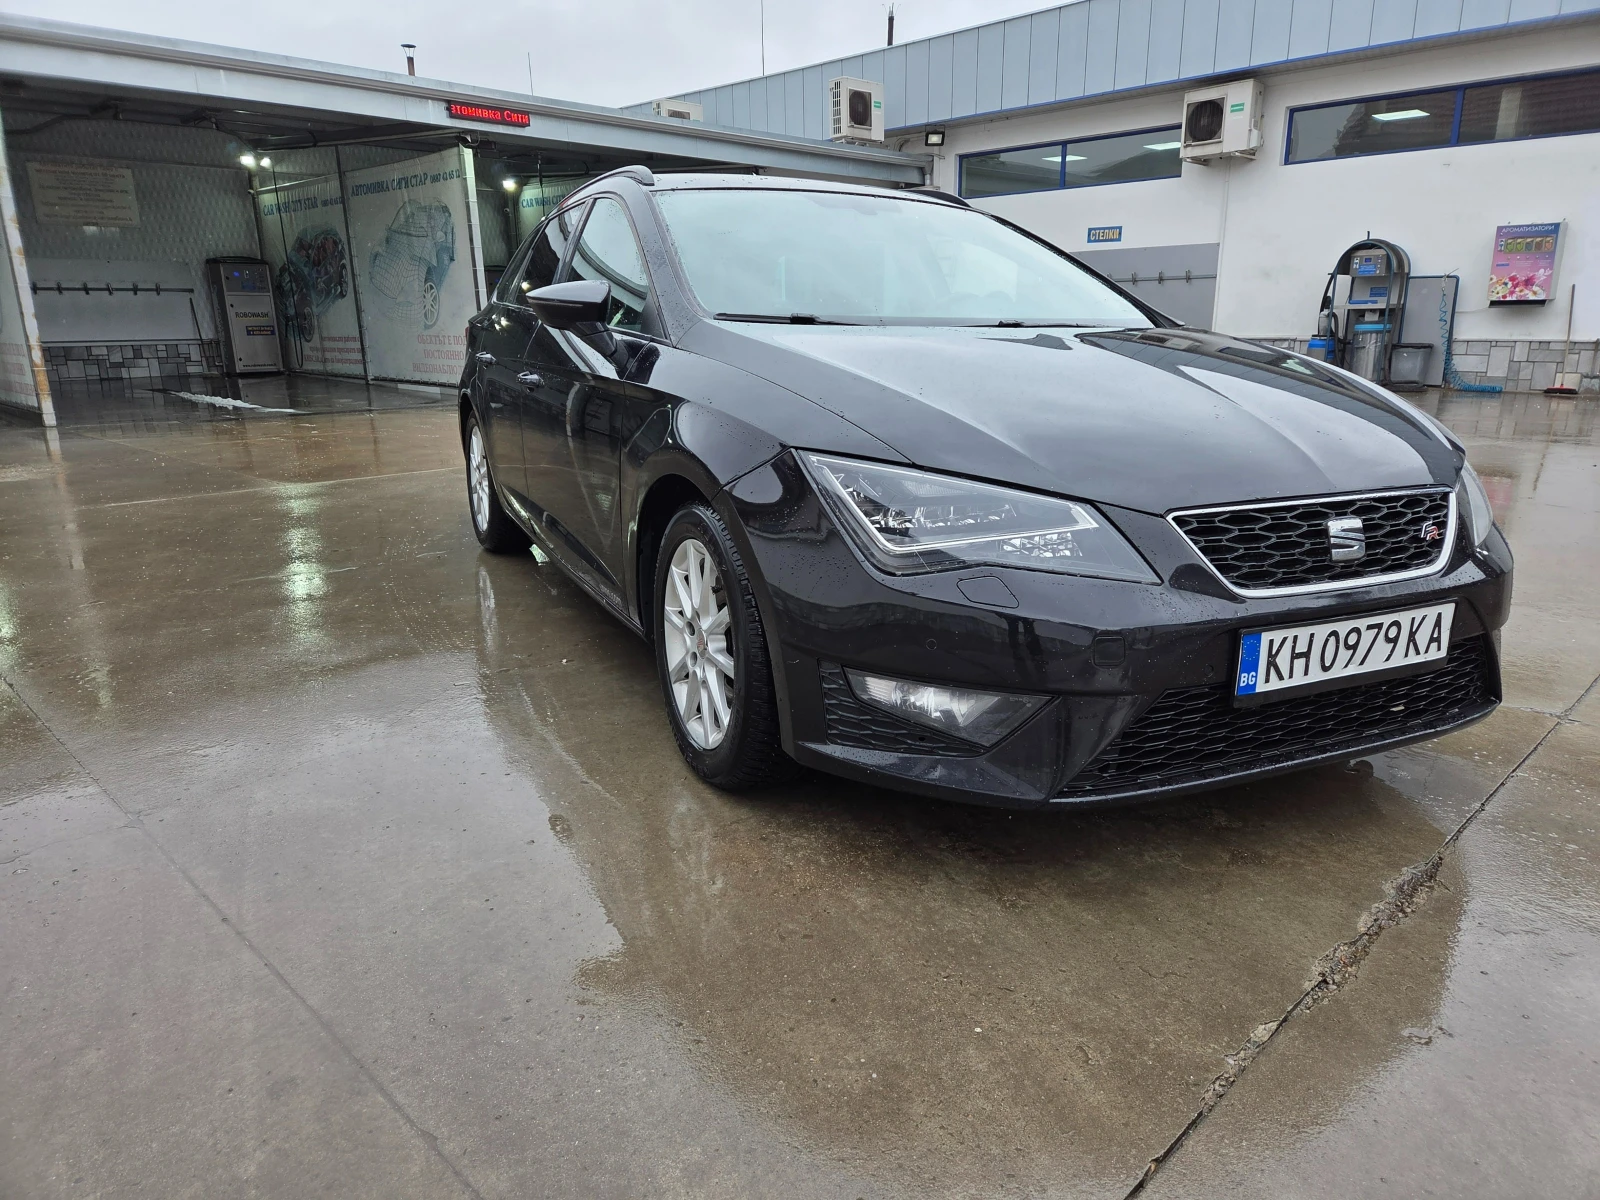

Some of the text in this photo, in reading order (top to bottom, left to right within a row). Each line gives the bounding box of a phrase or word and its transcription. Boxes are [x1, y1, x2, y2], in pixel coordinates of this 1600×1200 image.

[504, 110, 529, 124] Сити
[351, 180, 390, 197] АВТОМИВКА
[410, 172, 428, 188] СТАР
[263, 202, 275, 216] CAR
[304, 196, 318, 211] STAR
[521, 197, 534, 208] CAR
[534, 195, 551, 207] WASH
[1090, 228, 1120, 241] СТЕЛКИ
[1501, 224, 1555, 233] АРОМАТИЗАТОРИ
[235, 311, 269, 319] ROBOWASH
[447, 335, 453, 346] Е
[423, 349, 465, 361] ПОСТОЯННО
[1239, 671, 1257, 687] BG
